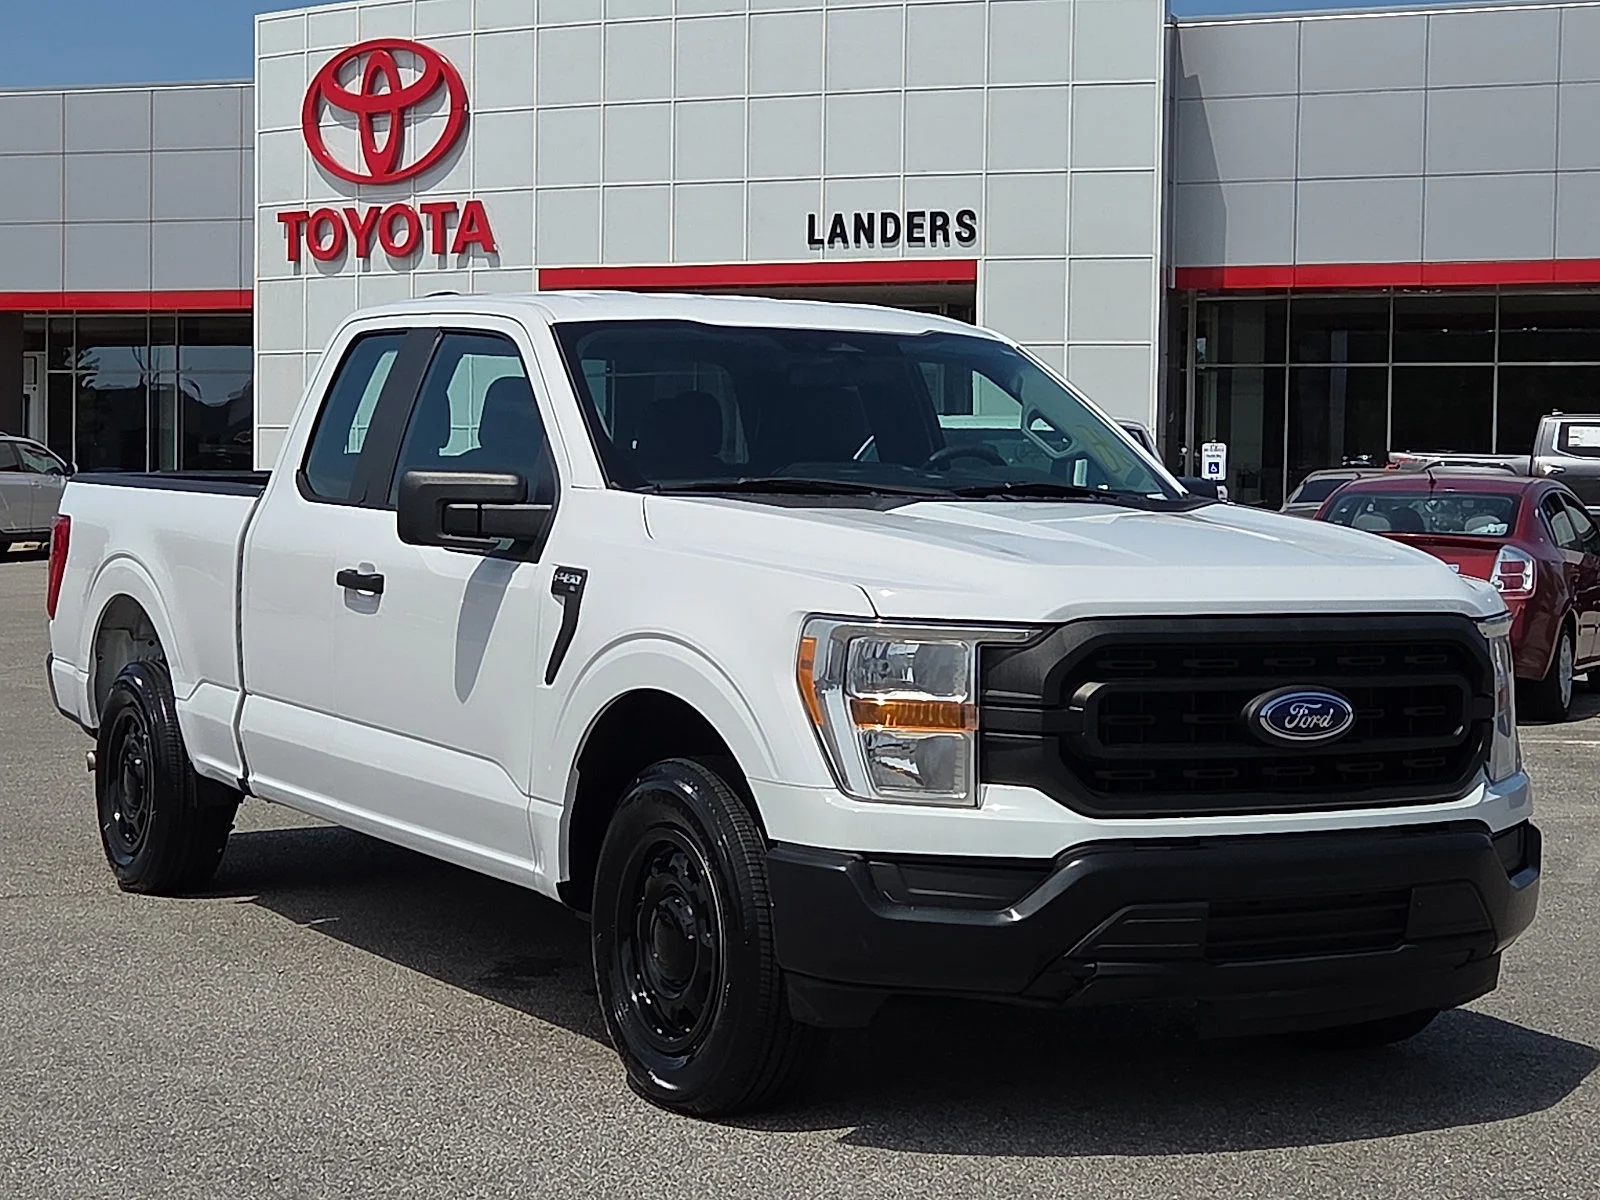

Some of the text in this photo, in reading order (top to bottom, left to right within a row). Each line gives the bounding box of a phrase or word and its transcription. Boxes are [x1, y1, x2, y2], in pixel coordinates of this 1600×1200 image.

[277, 200, 498, 262] TOYOTA
[807, 209, 977, 246] LANDERS
[1284, 702, 1334, 729] Ford
